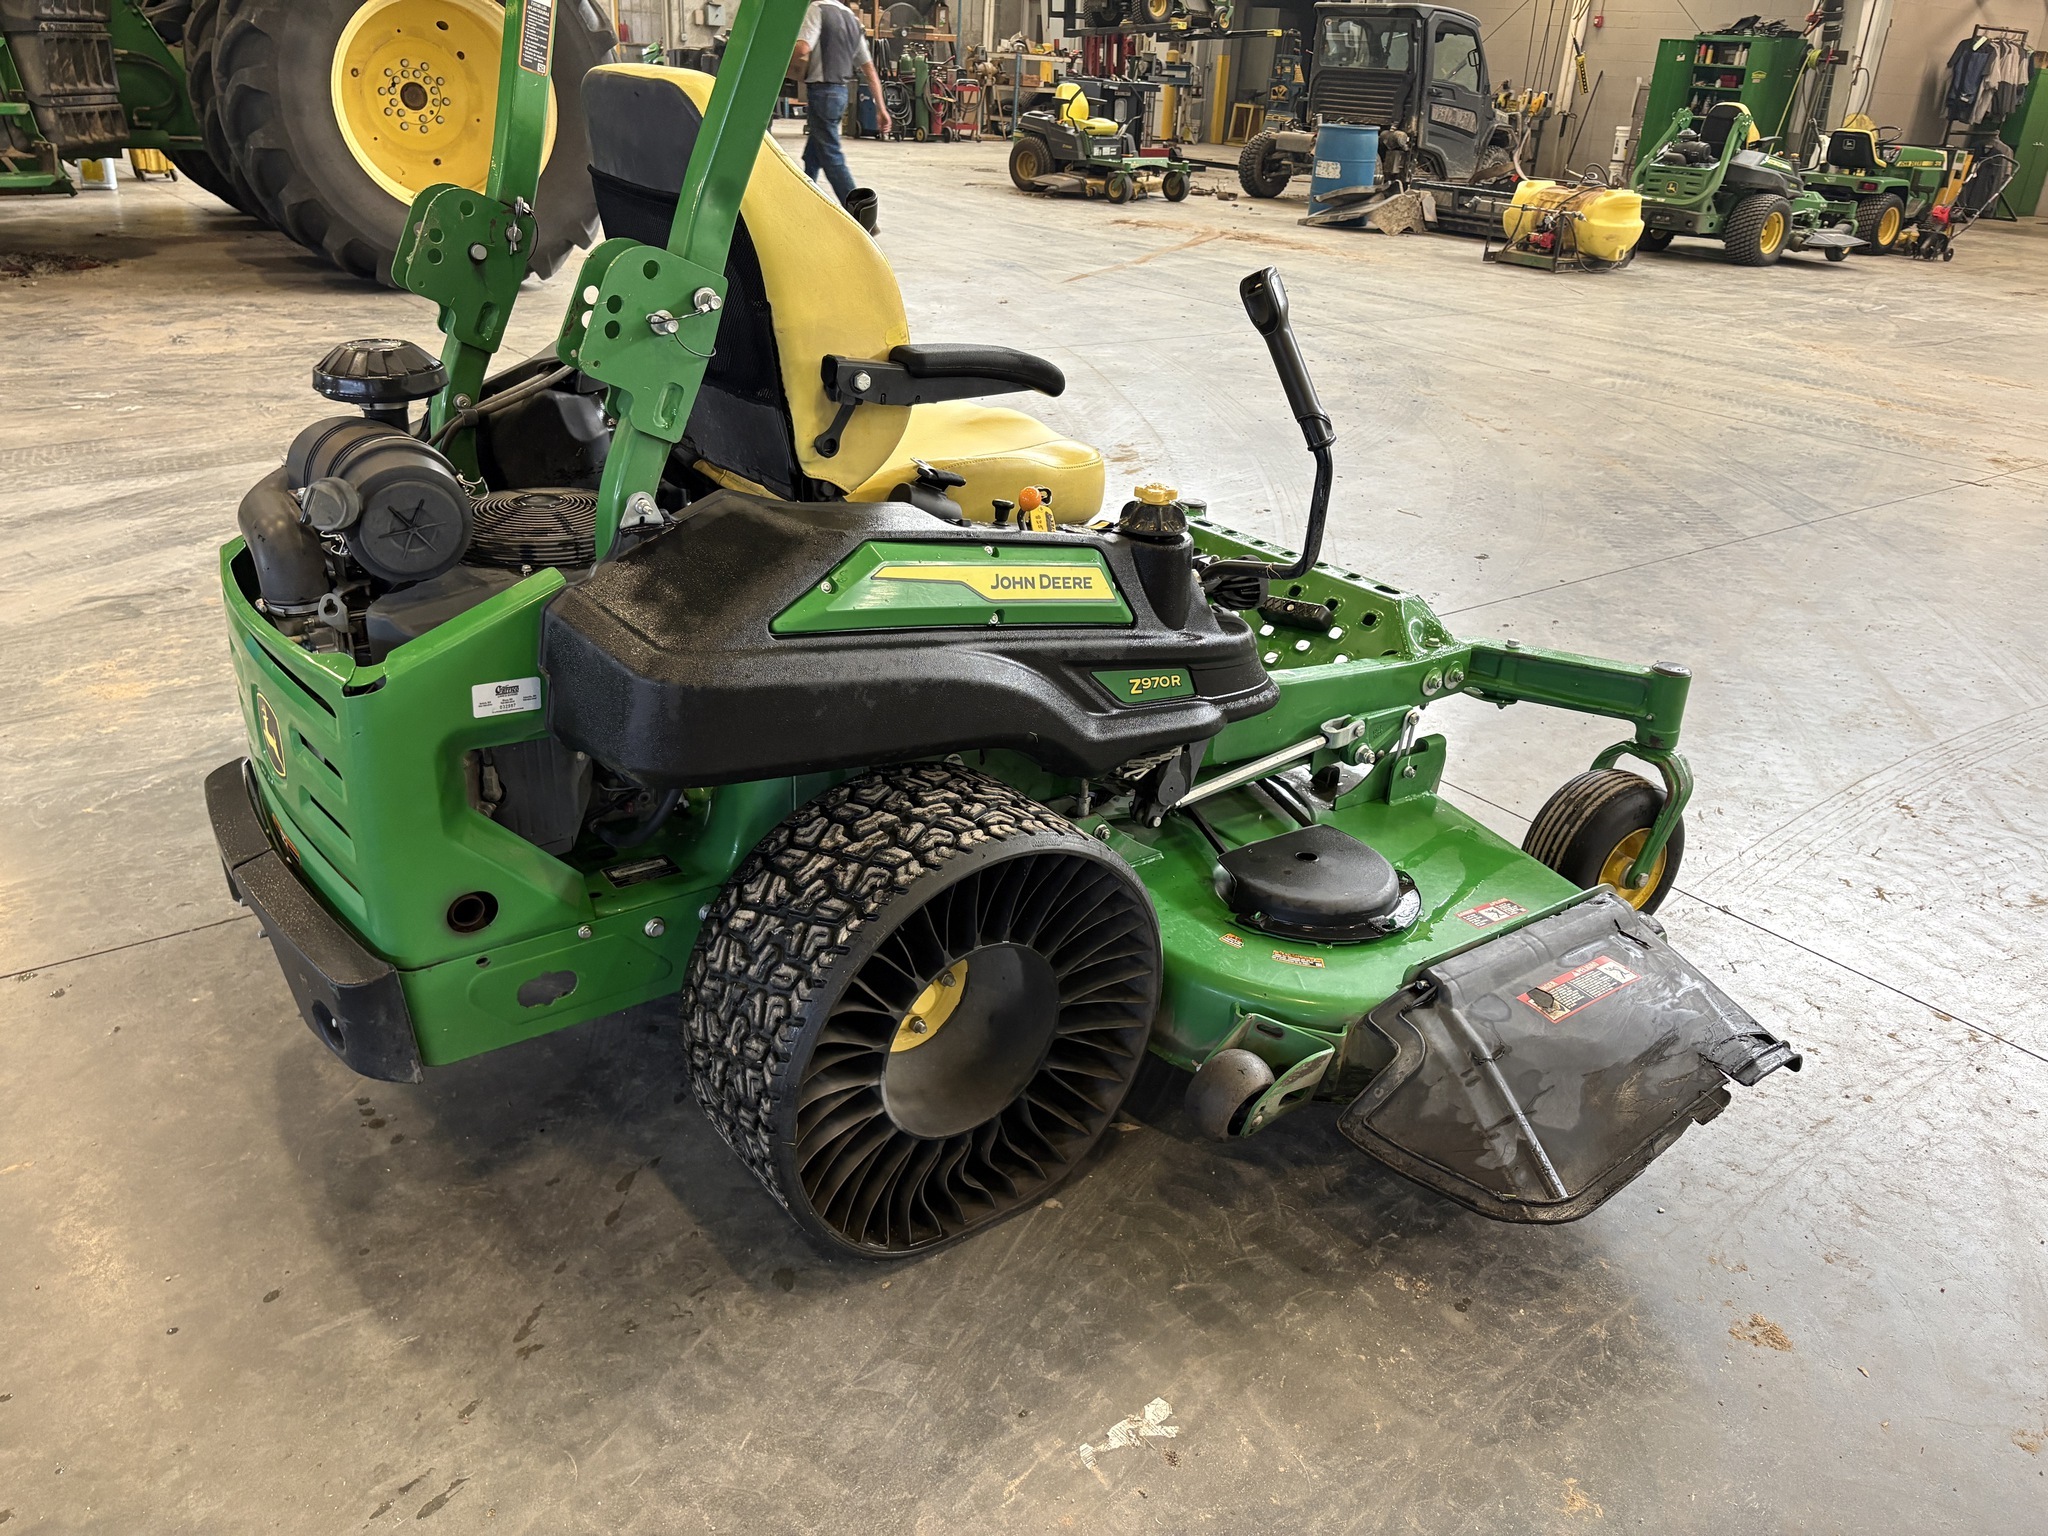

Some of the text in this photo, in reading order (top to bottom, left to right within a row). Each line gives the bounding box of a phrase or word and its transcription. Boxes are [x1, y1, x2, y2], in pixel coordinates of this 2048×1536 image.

[990, 573, 1093, 590] JOHN DEERE
[1128, 675, 1182, 695] Z970R
